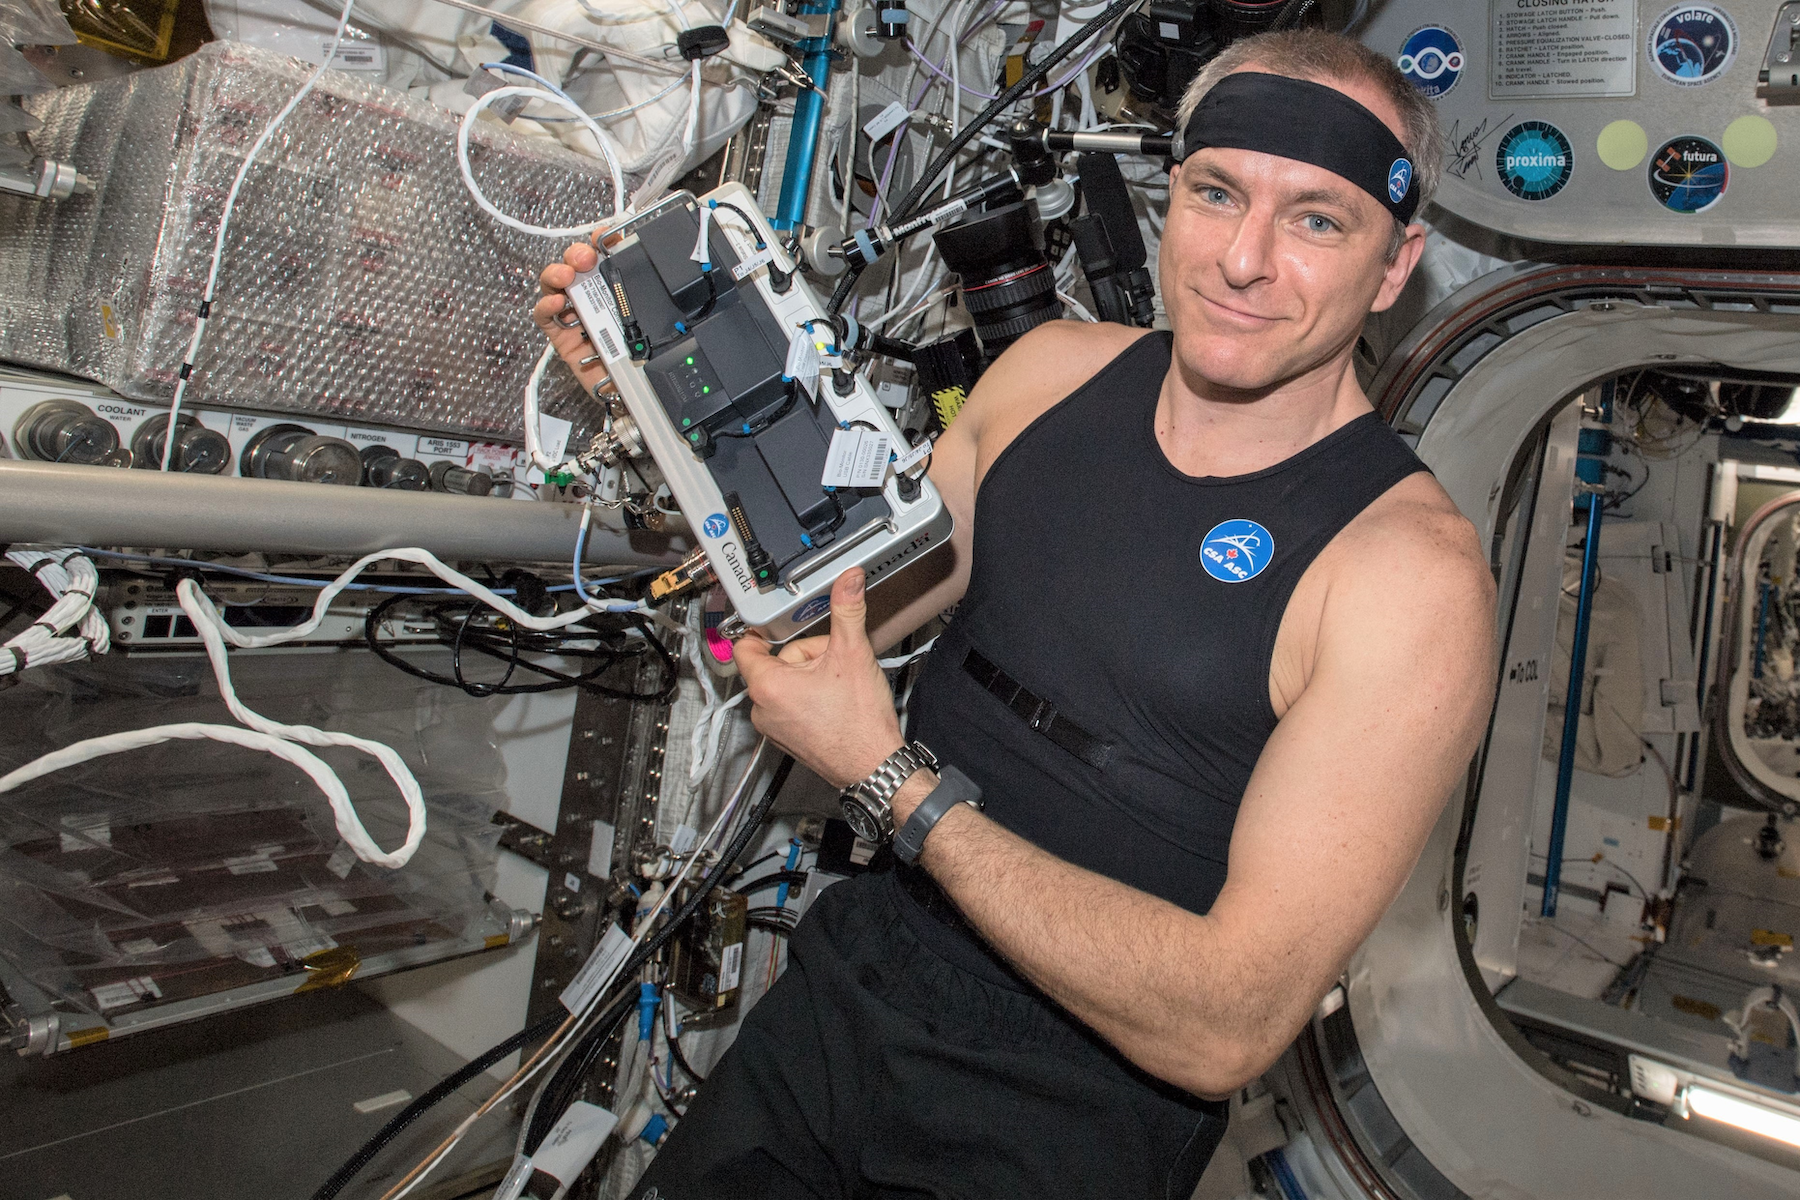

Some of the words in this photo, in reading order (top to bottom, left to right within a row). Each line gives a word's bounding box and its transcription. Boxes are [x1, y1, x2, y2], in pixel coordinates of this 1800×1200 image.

[1676, 10, 1714, 24] volare
[1662, 72, 1686, 87] EUROPEAN
[1704, 72, 1722, 84] AGENCY
[1506, 152, 1566, 170] proxima
[1682, 150, 1718, 162] futura
[734, 265, 744, 274] P1
[594, 274, 615, 306] Bio-Monitor
[98, 404, 147, 417] COOLANT
[350, 433, 386, 443] NITROGEN
[446, 441, 461, 449] 1553
[923, 446, 932, 456] P1
[837, 450, 847, 478] Bio-Monitor
[865, 536, 932, 580] anada
[1203, 547, 1224, 564] CSA
[1223, 562, 1248, 579] ASC
[722, 542, 752, 594] Canada
